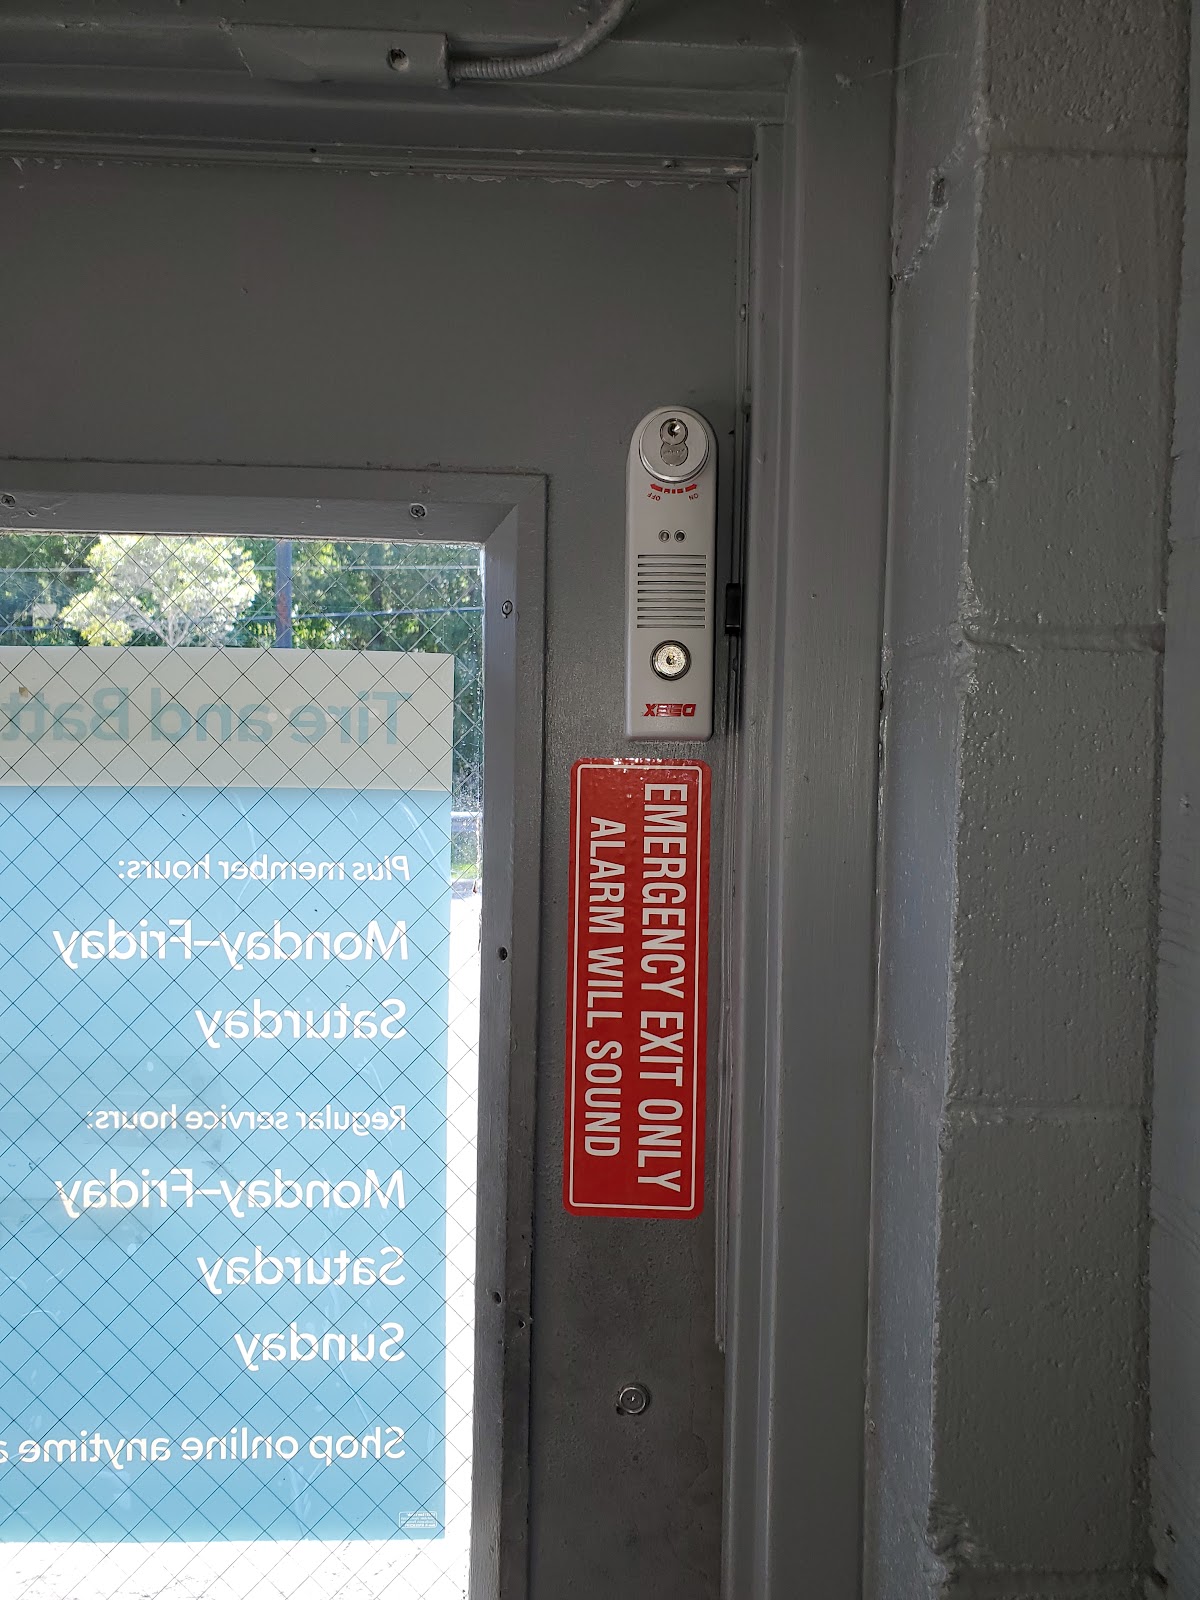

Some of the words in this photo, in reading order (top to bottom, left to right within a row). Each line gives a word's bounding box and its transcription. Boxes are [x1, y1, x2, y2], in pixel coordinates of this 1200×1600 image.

[647, 492, 661, 501] OFF
[688, 492, 699, 501] ON
[589, 816, 626, 934] ALARM
[641, 783, 688, 998] EMERGENCY
[586, 945, 624, 1028] WILL
[639, 1010, 684, 1087] EXIT
[584, 1040, 623, 1157] SOUND
[637, 1098, 683, 1193] ONLY
